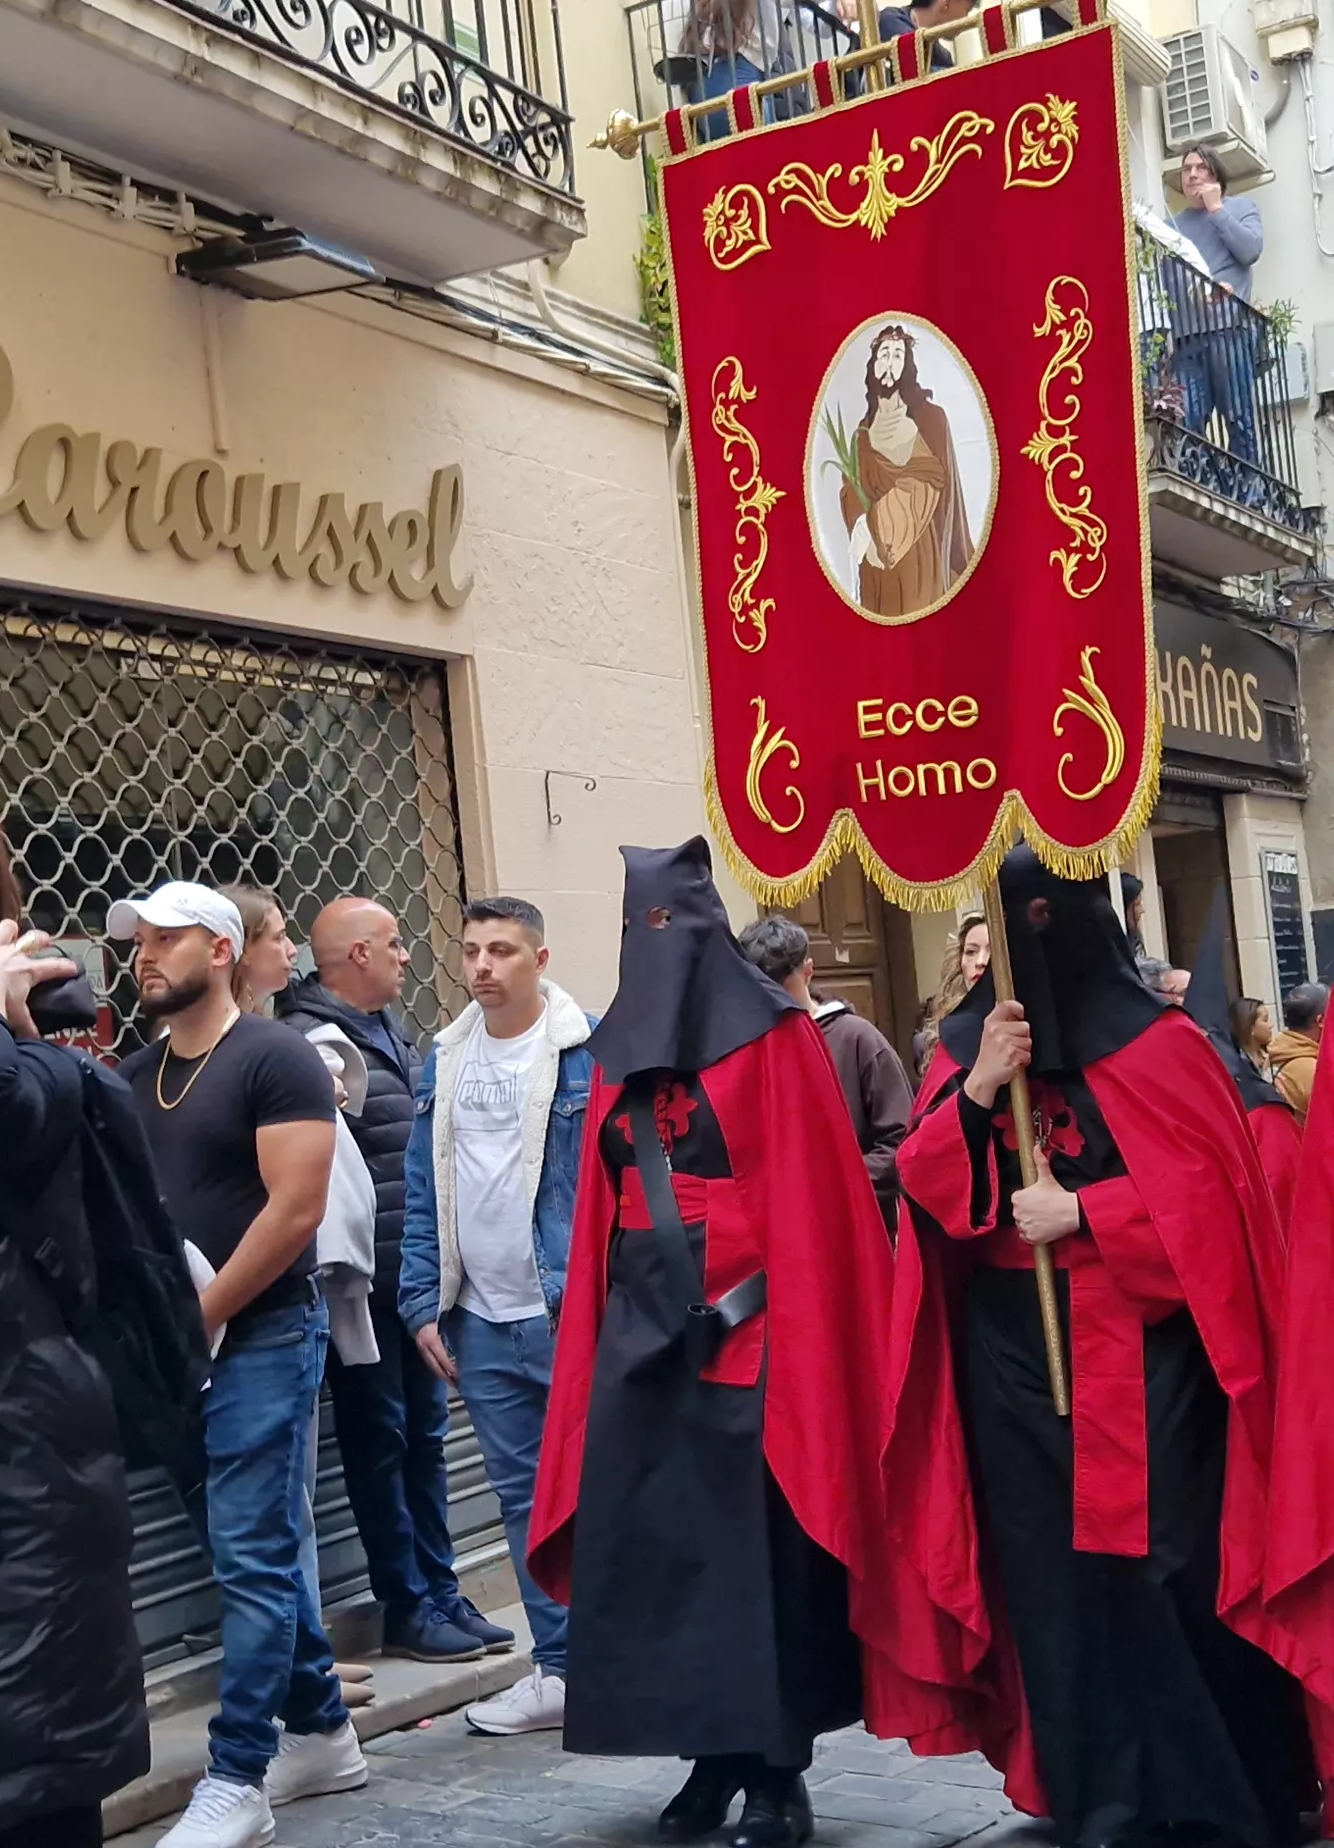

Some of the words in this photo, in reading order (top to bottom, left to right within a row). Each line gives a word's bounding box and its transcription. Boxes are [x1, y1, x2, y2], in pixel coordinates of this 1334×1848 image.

[1154, 643, 1263, 742] KAÑAS
[856, 694, 980, 740] Ecce
[855, 757, 997, 803] Homo
